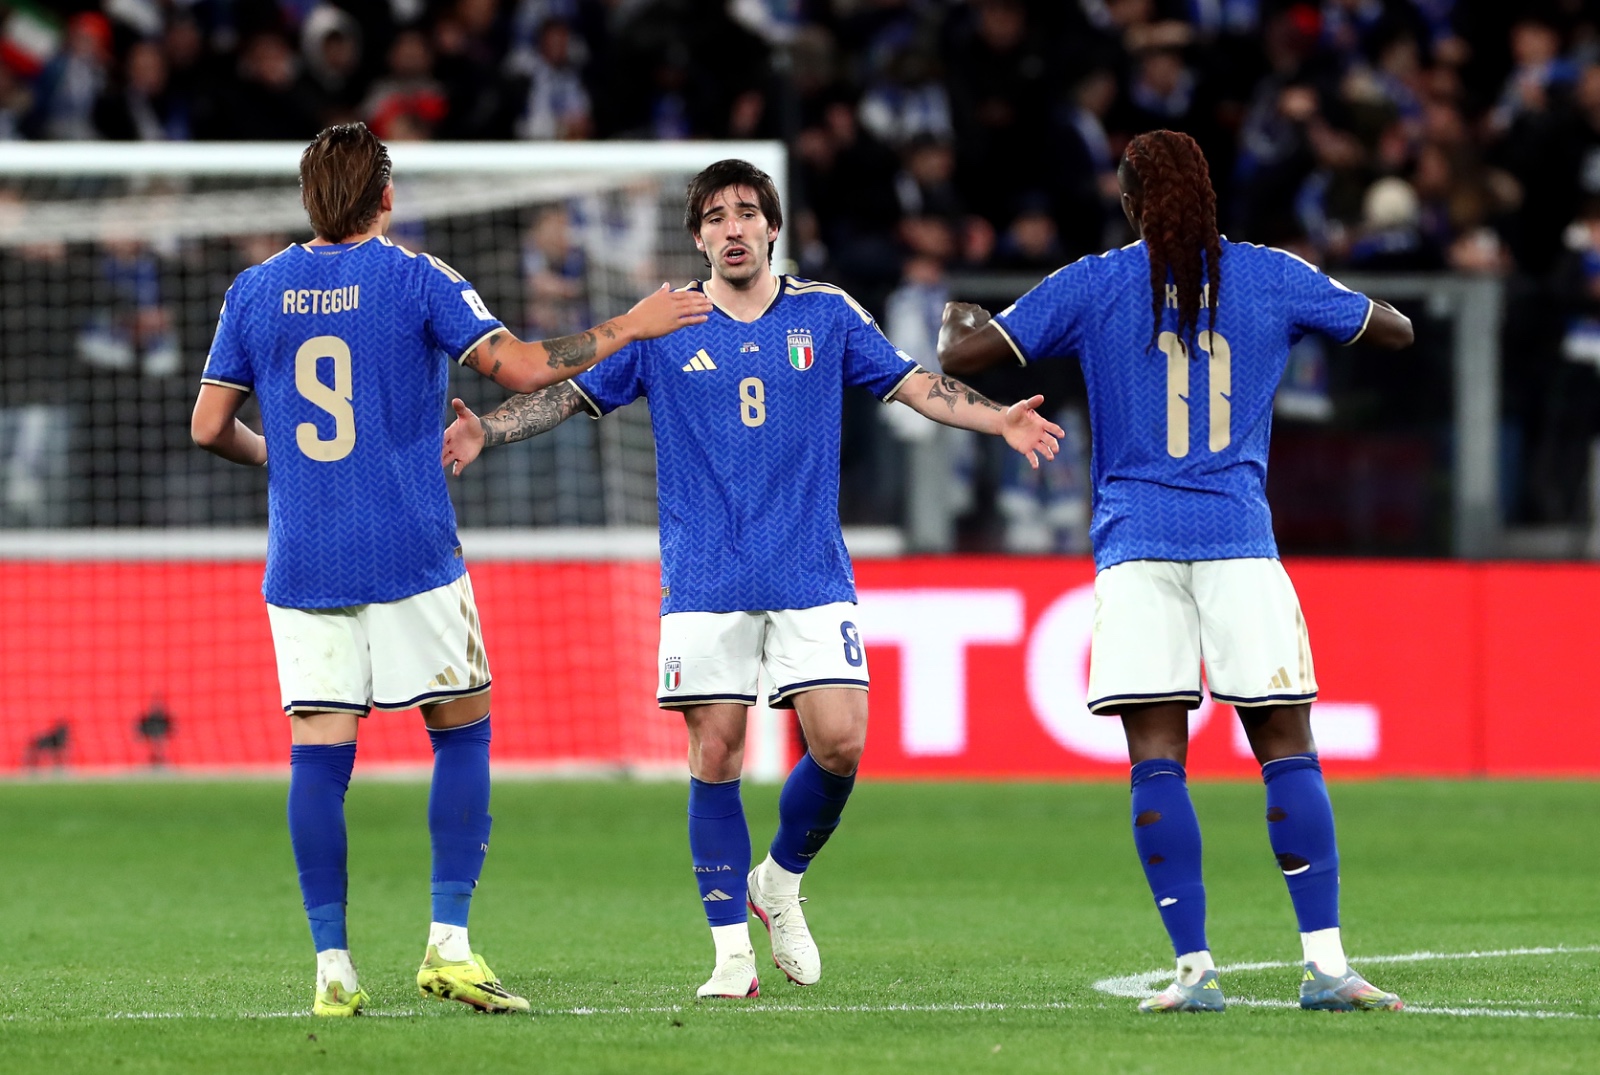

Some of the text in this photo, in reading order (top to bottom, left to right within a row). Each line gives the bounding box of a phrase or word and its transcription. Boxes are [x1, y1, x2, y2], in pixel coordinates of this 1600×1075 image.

[283, 284, 359, 315] RETEGUI
[789, 336, 811, 345] ITALIA
[295, 335, 356, 462] 9
[739, 377, 766, 427] 8
[1158, 330, 1232, 458] 11
[840, 620, 863, 667] 8
